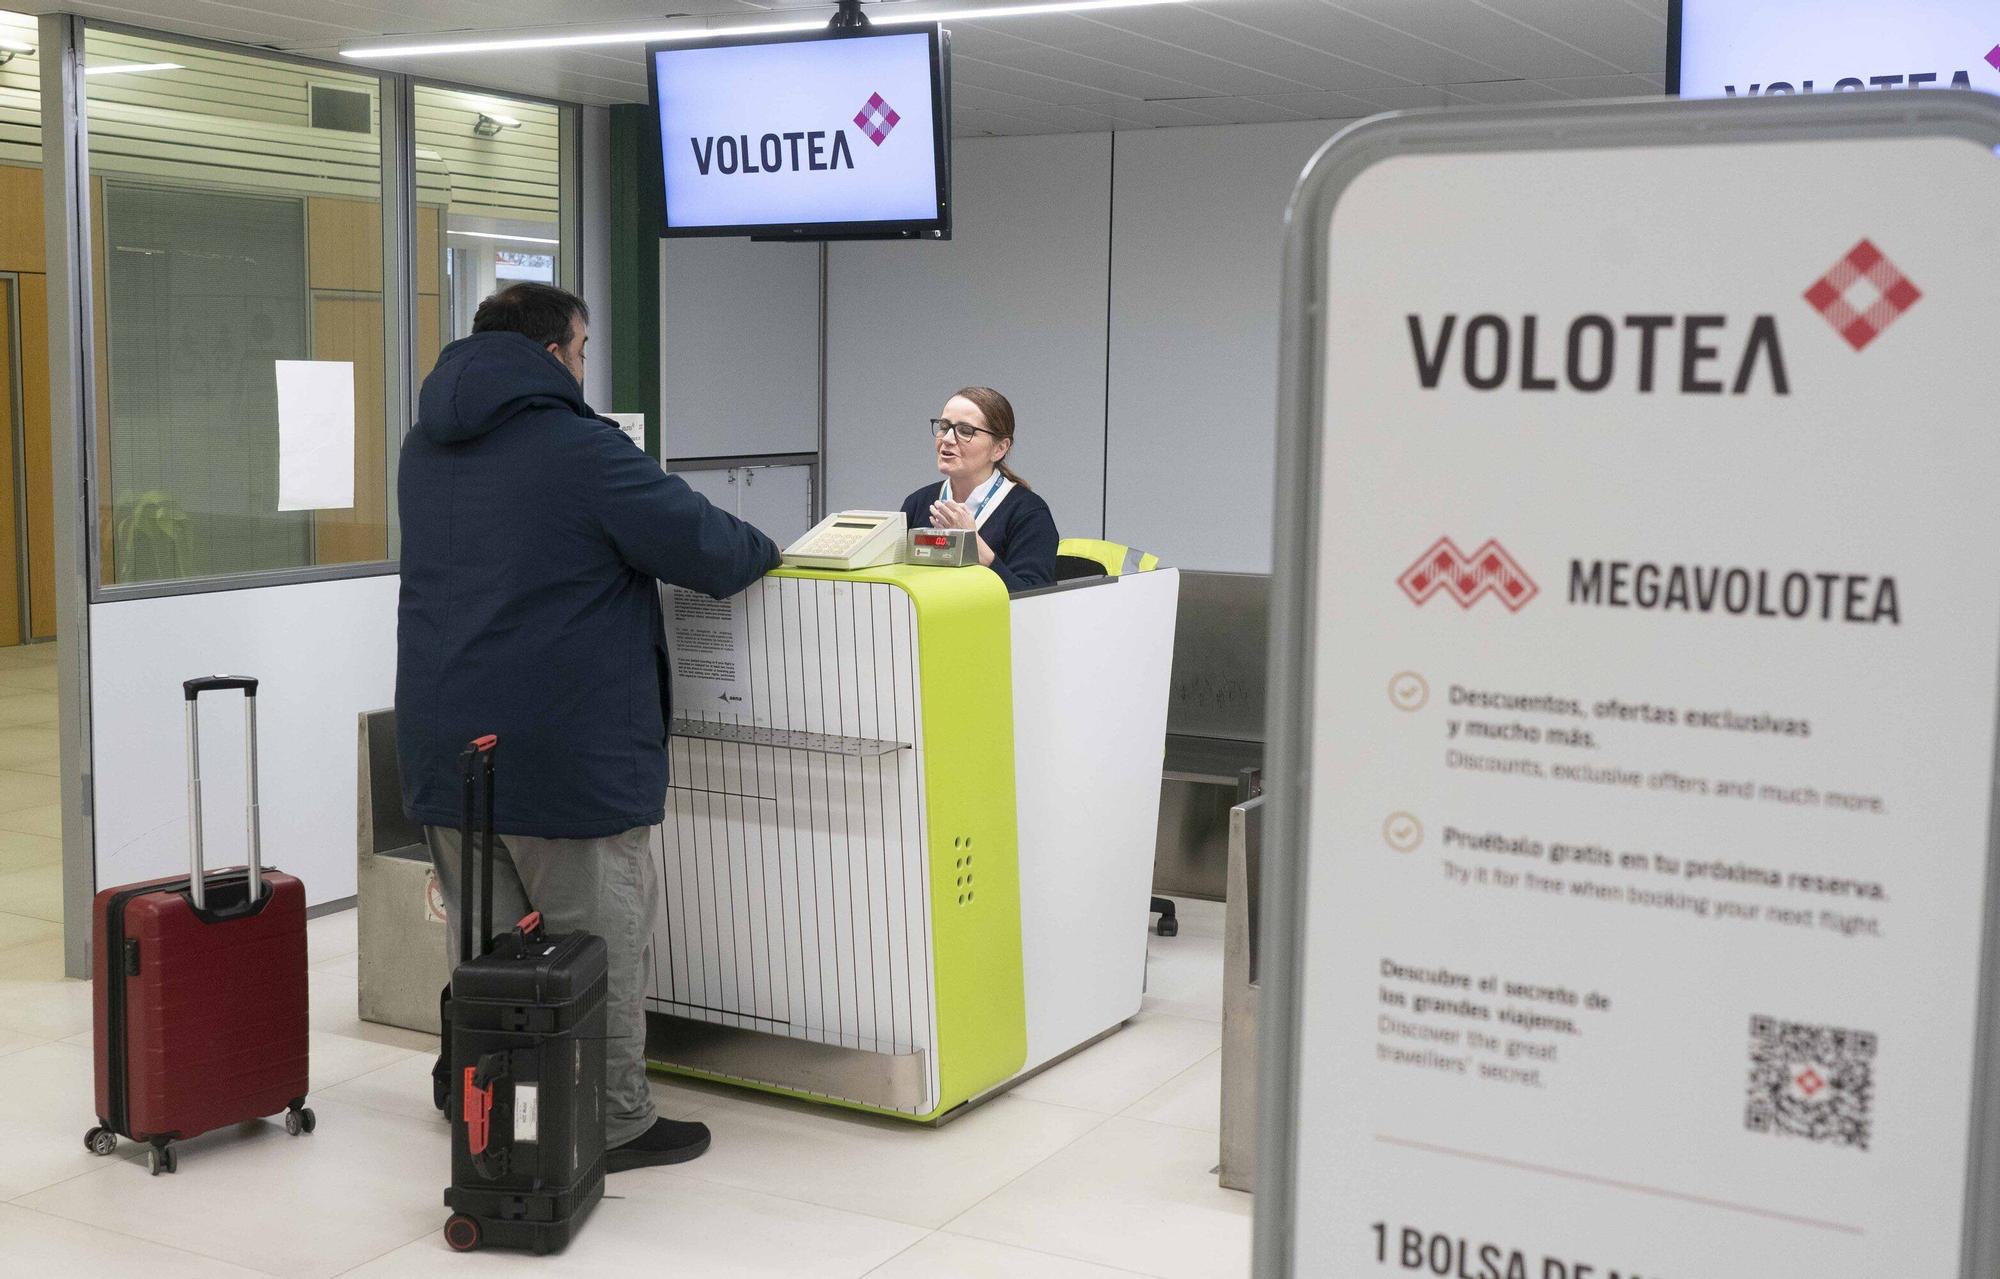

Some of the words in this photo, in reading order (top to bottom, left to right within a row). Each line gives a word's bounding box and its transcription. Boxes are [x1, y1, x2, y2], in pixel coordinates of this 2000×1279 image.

[690, 130, 855, 176] VOLOTEA
[1406, 313, 1790, 396] VOLOTEA
[1567, 557, 1902, 626] MEGAVOLOTEA
[1446, 720, 1461, 740] y
[1465, 718, 1541, 743] mucho
[1545, 726, 1597, 749] más.
[1448, 685, 1587, 718] Descuentos,
[1592, 699, 1678, 725] ofertas
[1684, 708, 1811, 737] exclusivas
[1445, 749, 1547, 778] Discounts,
[1552, 763, 1643, 788] exclusive
[1647, 771, 1709, 796] offers
[1714, 779, 1755, 799] and
[1759, 783, 1821, 806] much
[1824, 790, 1888, 814] more.
[1443, 826, 1544, 858] Pruébalo
[1548, 841, 1615, 866] gratis
[1619, 852, 1649, 870] en
[1654, 854, 1681, 875] tu
[1684, 860, 1782, 888] próxima
[1786, 872, 1890, 901] reserva.
[1443, 860, 1471, 885] Try
[1474, 866, 1489, 883] it
[1492, 867, 1519, 888] for
[1525, 872, 1564, 895] free
[1569, 880, 1625, 902] when
[1626, 885, 1709, 915] booking
[1713, 899, 1760, 921] your
[1765, 905, 1814, 927] next
[1818, 909, 1883, 938] flight.
[1379, 985, 1407, 1008] los
[1412, 994, 1491, 1020] grandes
[1497, 1007, 1581, 1037] viajeros.
[1380, 957, 1472, 990] Descubre
[1477, 974, 1499, 993] el
[1503, 979, 1579, 1007] secreto
[1583, 990, 1612, 1011] de
[1377, 1013, 1461, 1044] Discover
[1465, 1029, 1500, 1050] the
[1505, 1037, 1558, 1062] great
[1477, 1060, 1547, 1088] secret.
[1370, 1221, 1387, 1263] 1
[1399, 1227, 1526, 1279] BOLSA
